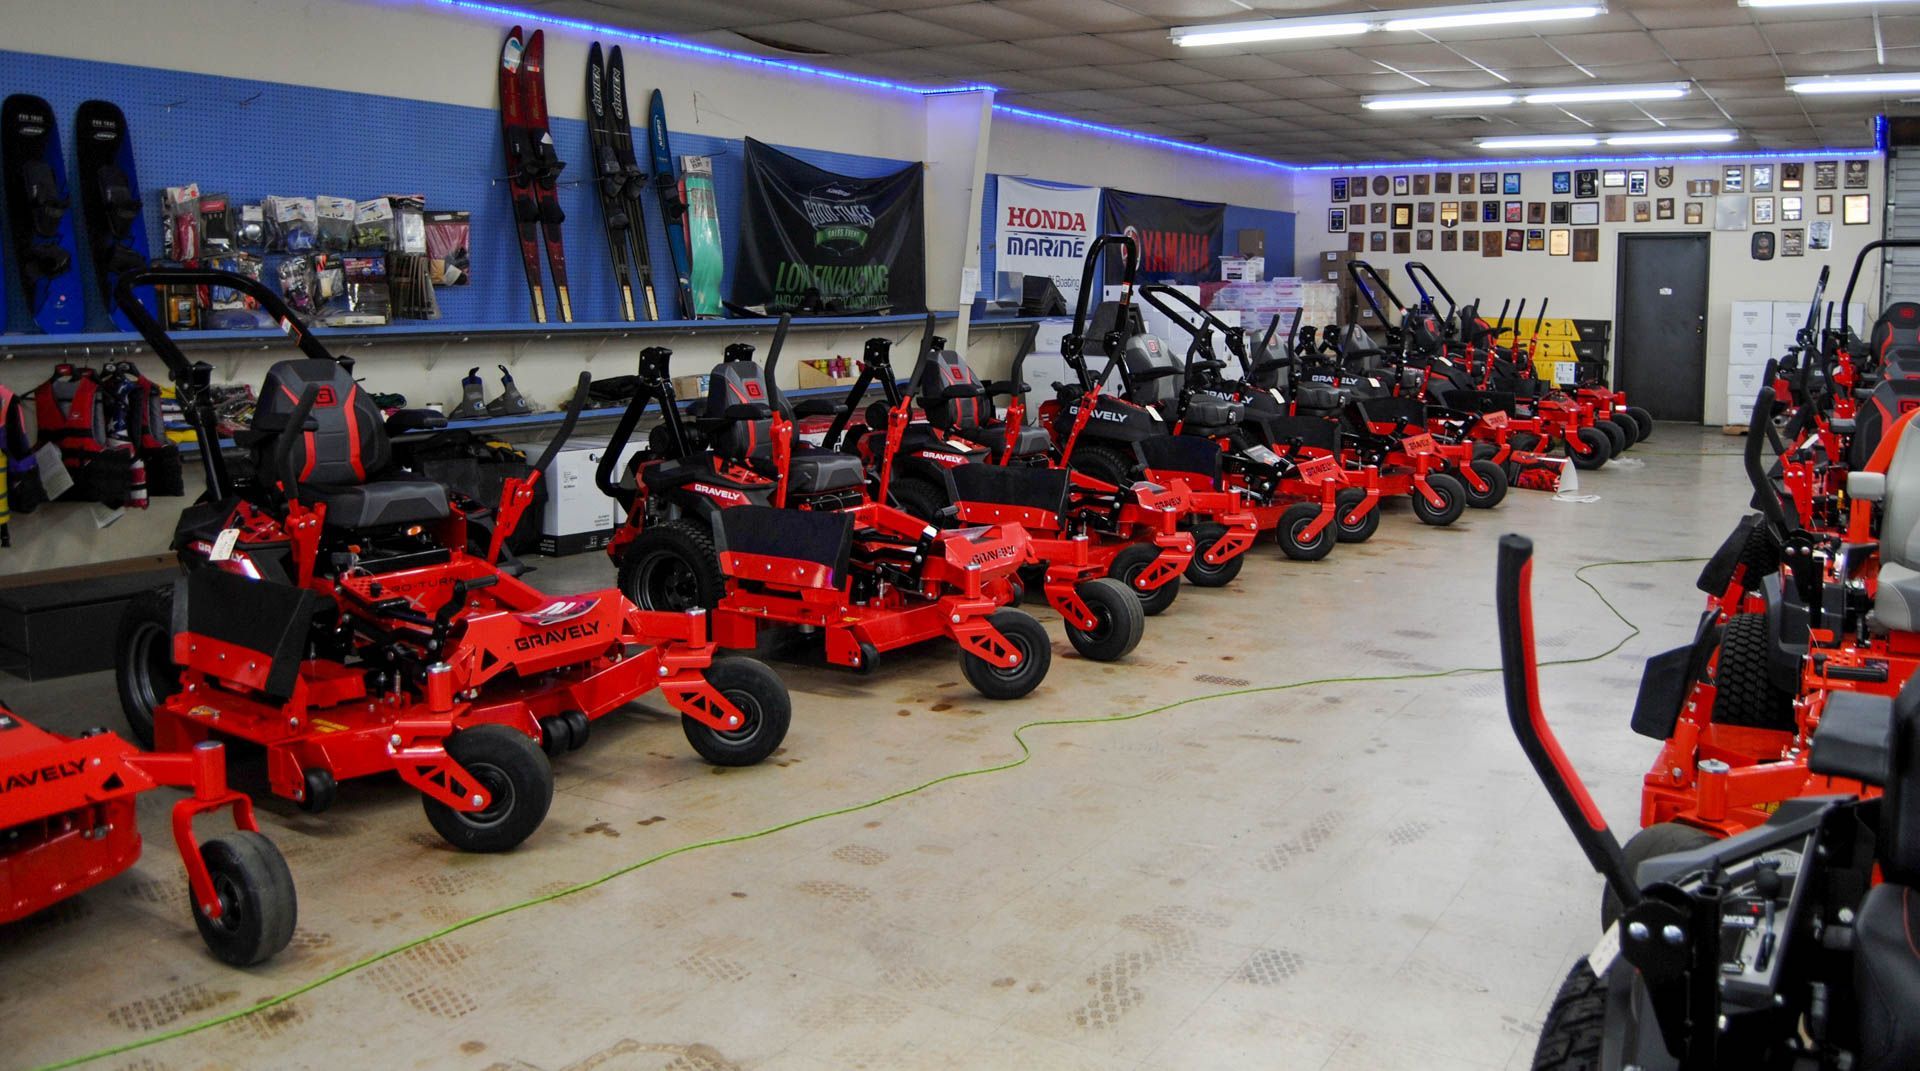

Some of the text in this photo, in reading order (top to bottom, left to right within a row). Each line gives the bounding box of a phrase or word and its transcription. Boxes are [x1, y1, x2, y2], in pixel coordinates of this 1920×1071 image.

[1007, 206, 1087, 232] HONDA
[1007, 233, 1085, 258] MARINE
[1142, 229, 1209, 273] YAMAHA
[812, 265, 889, 297] FINANCING
[1055, 275, 1080, 291] Boating
[1311, 374, 1358, 385] GRAELY
[1069, 406, 1128, 423] GAVELY
[922, 451, 962, 463] GRAVELY
[694, 483, 740, 501] GRAVELY
[198, 542, 244, 563] GRLY
[514, 620, 600, 651] GRAVELY
[0, 757, 86, 793] AVELY
